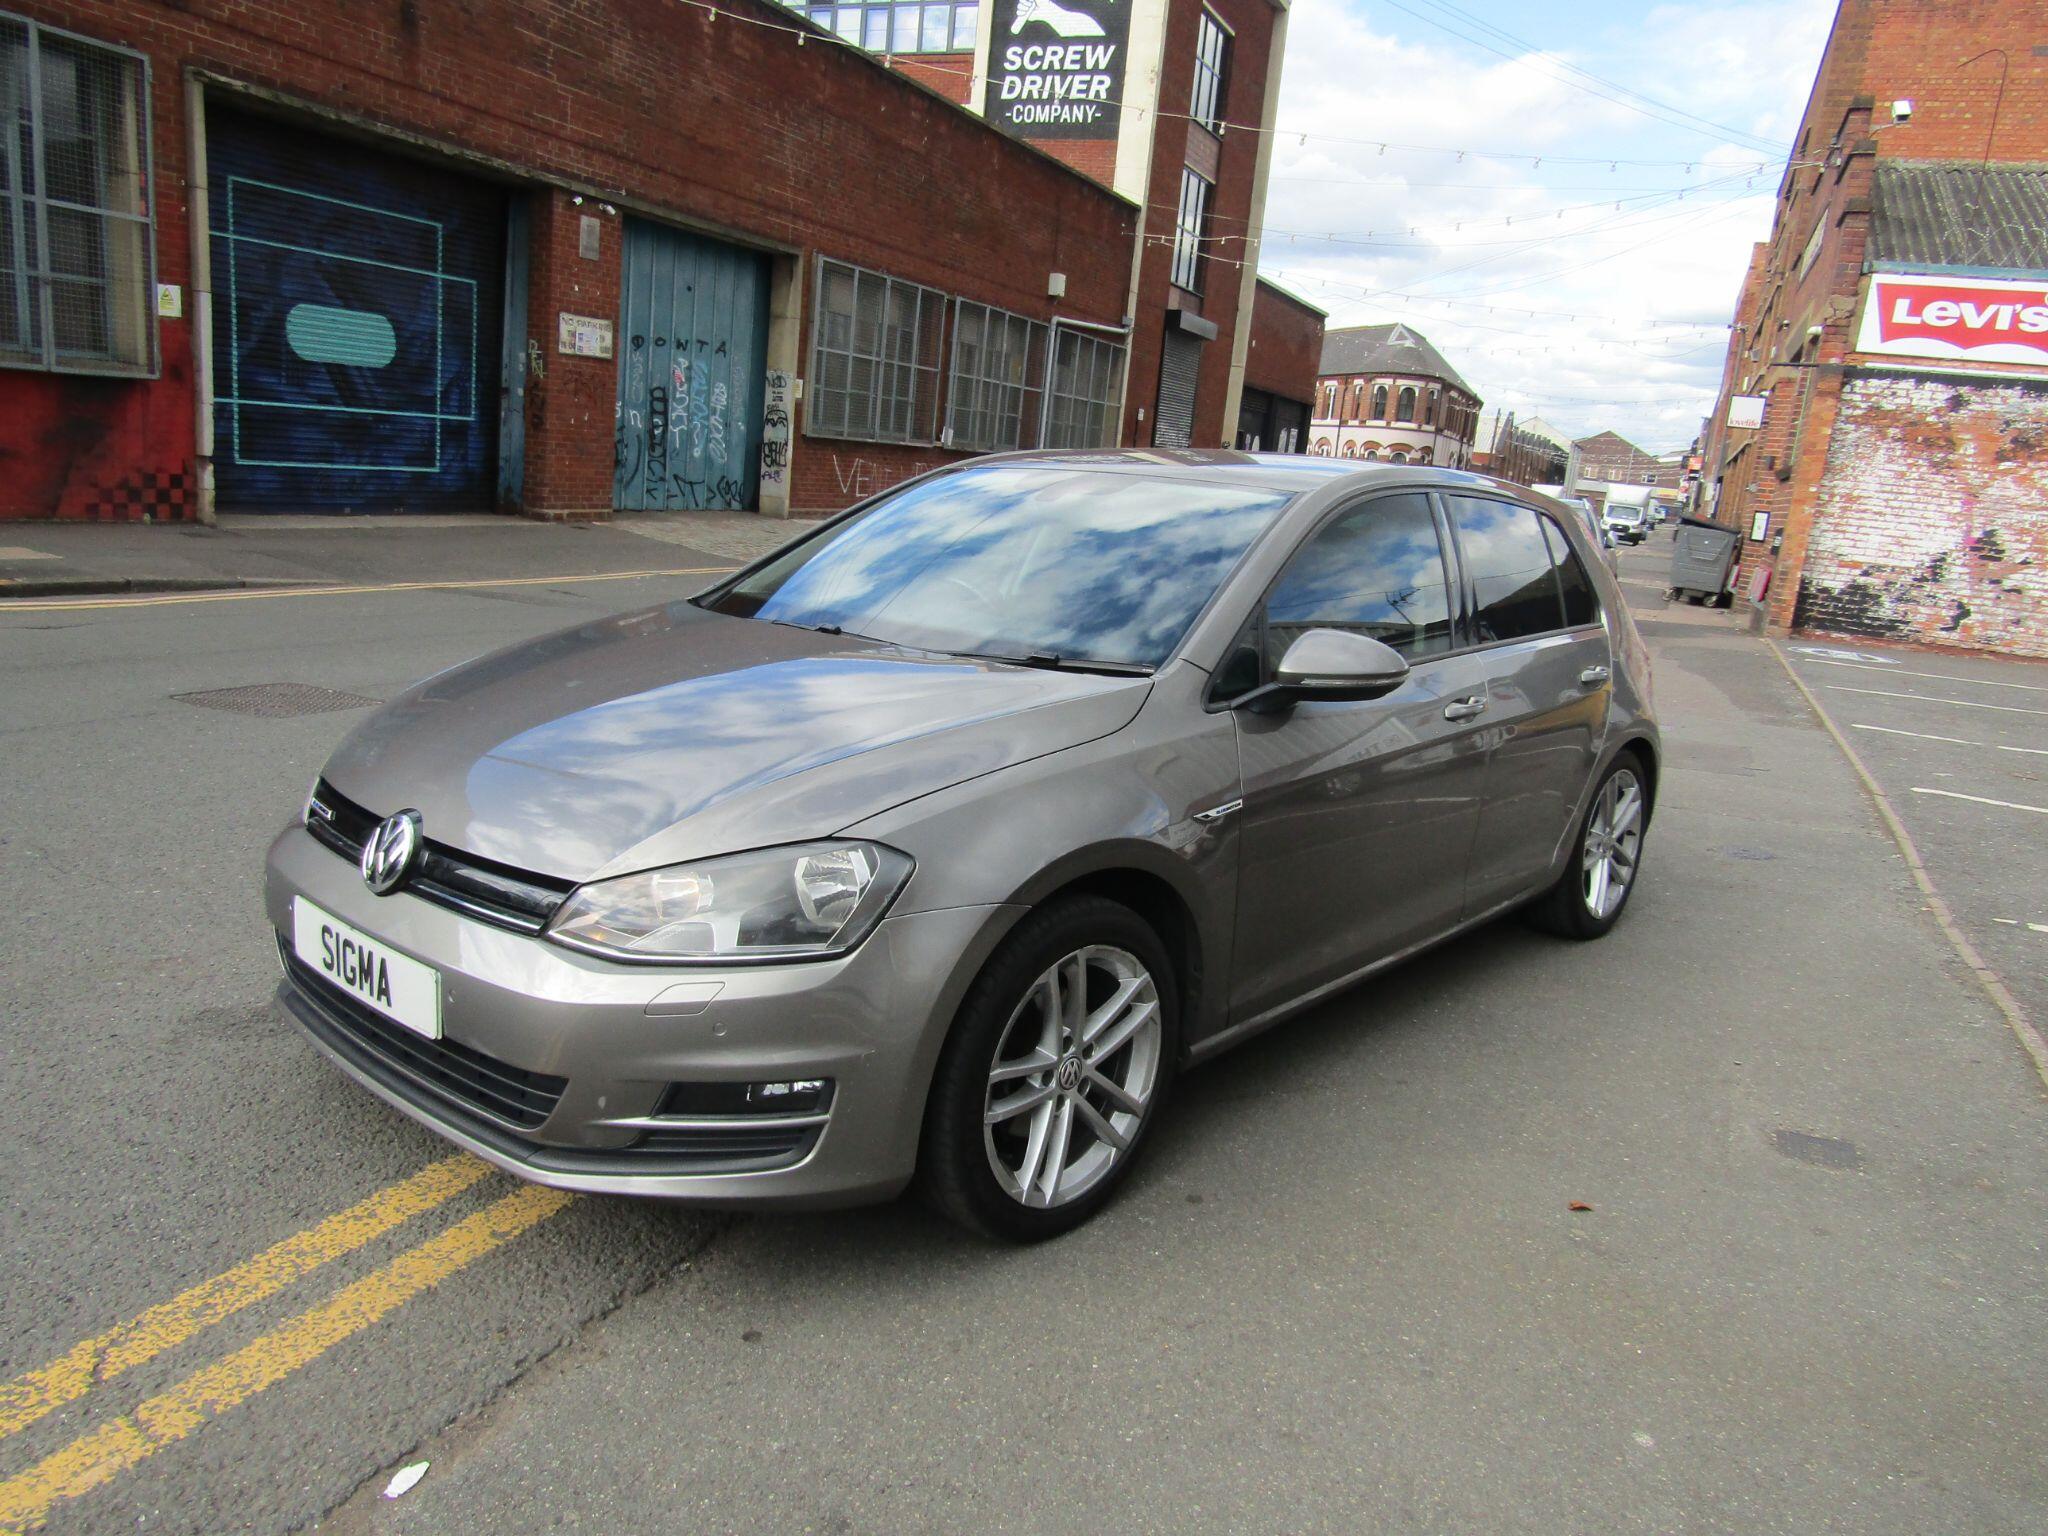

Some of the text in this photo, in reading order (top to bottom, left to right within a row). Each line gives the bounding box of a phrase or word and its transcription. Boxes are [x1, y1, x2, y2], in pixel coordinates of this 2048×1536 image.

[1003, 45, 1117, 71] SCREW
[1000, 74, 1112, 101] DRIVER
[321, 924, 392, 1009] SIGMA
